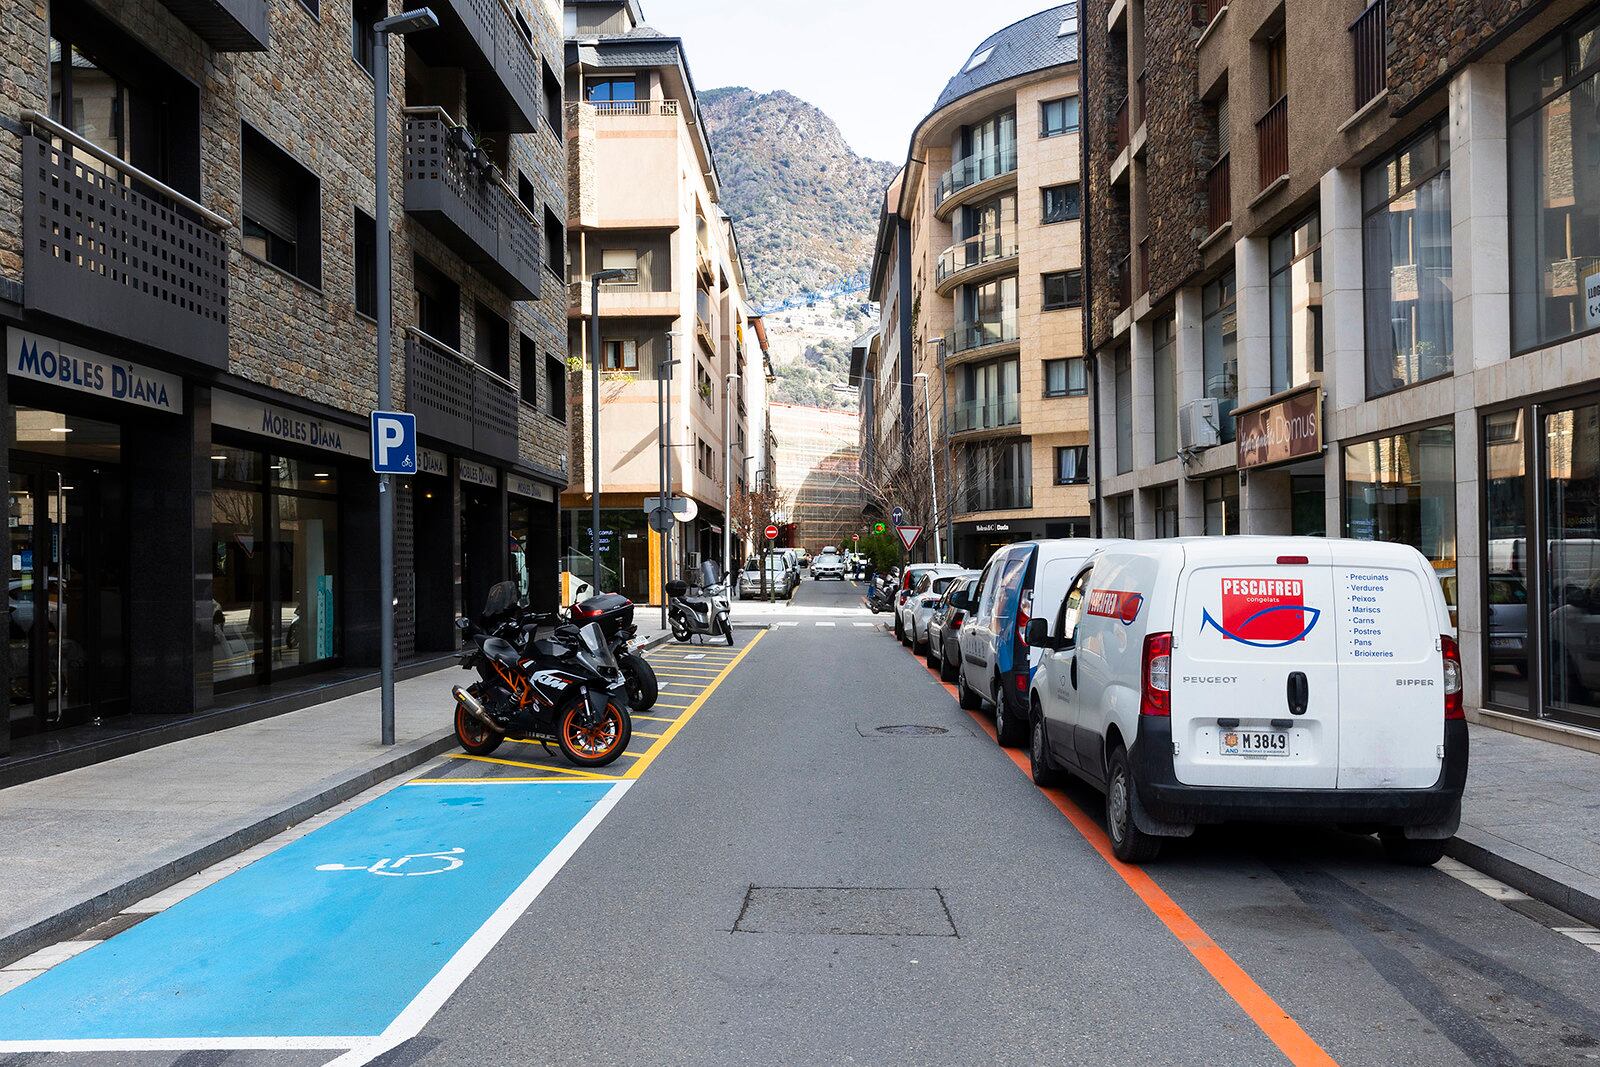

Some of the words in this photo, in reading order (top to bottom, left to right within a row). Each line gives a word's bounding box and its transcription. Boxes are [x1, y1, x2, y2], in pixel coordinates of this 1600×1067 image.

[18, 336, 104, 391] MOBLES
[262, 408, 307, 441] MOBLES
[378, 418, 405, 466] P
[1350, 573, 1389, 581] Precuinats
[1223, 580, 1301, 596] PESCAFRED
[1350, 584, 1384, 592] Verdures
[1246, 596, 1280, 604] congelats
[1351, 595, 1377, 603] Peixos
[1352, 606, 1381, 614] Mariscs
[1352, 616, 1375, 624] Carns
[1353, 627, 1382, 635] Postres
[1354, 638, 1372, 646] Pans
[1354, 649, 1394, 657] Brioixeries
[537, 674, 568, 690] KTM
[1182, 676, 1238, 684] PEUGEOT
[1242, 734, 1251, 748] M
[1254, 734, 1286, 749] 3849
